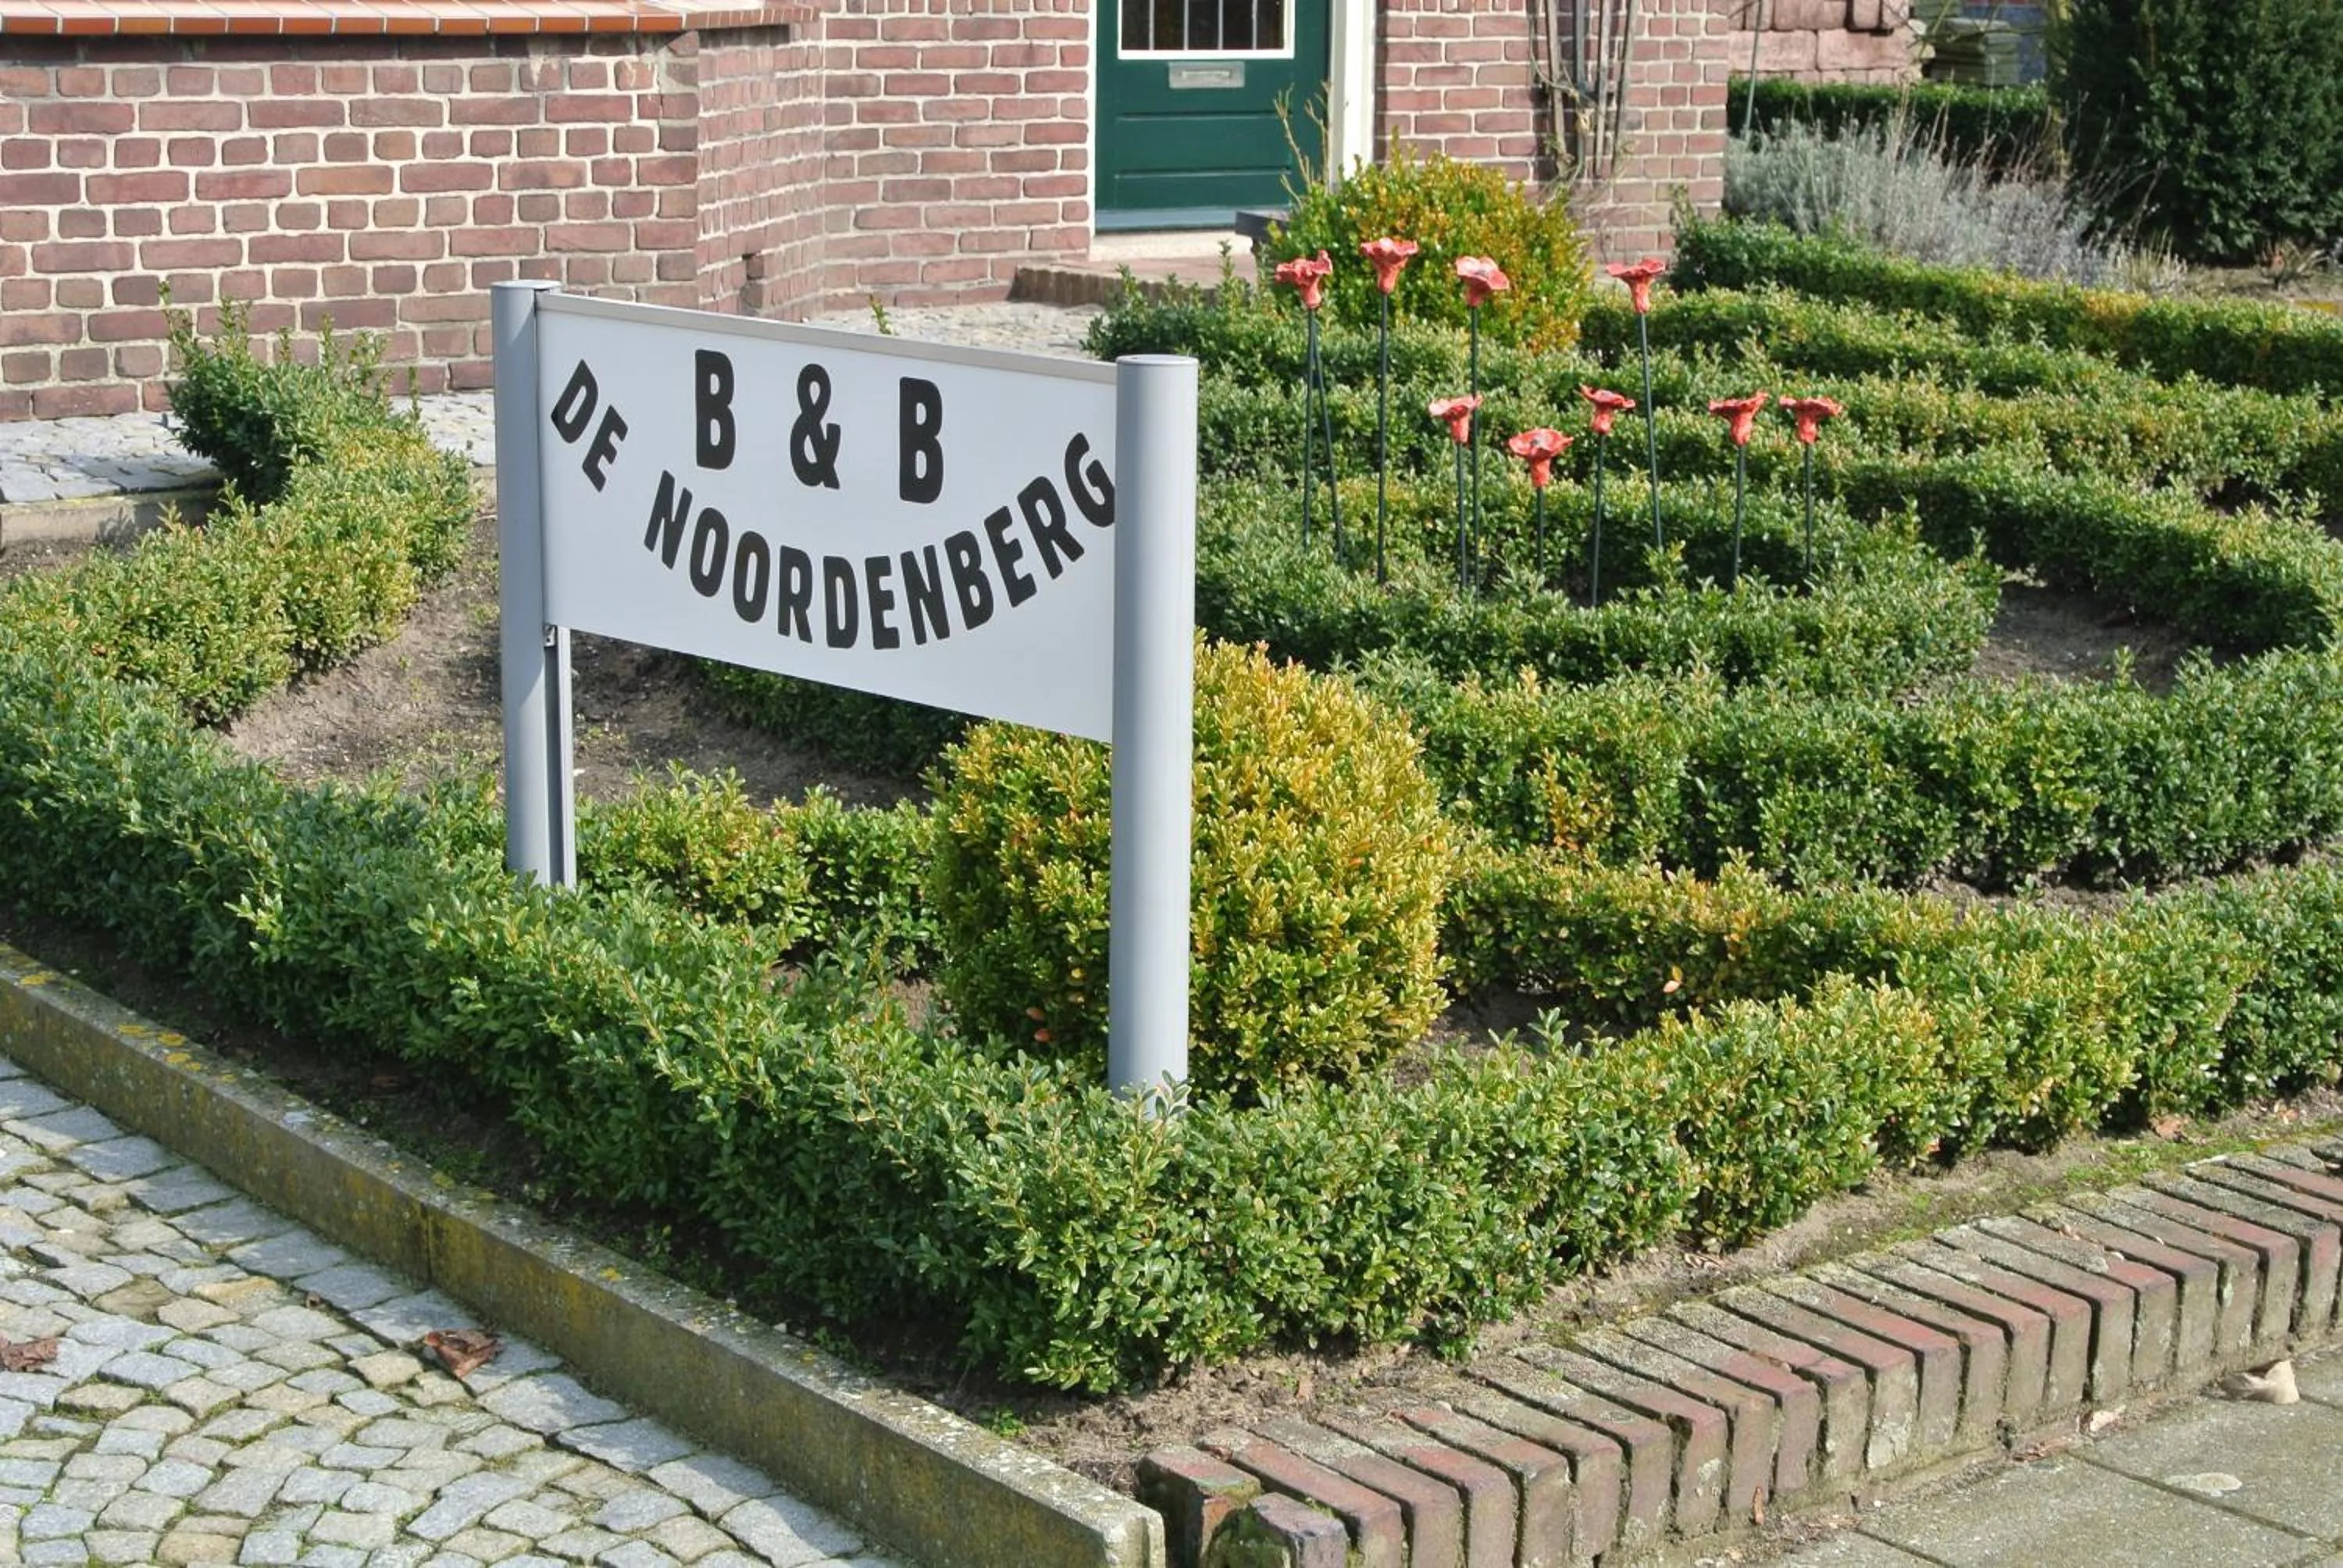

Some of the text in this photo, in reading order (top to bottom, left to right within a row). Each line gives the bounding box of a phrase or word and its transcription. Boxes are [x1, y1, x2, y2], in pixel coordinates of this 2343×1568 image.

[551, 360, 1115, 650] DE NOORDENBERG
[695, 349, 943, 504] B & B
